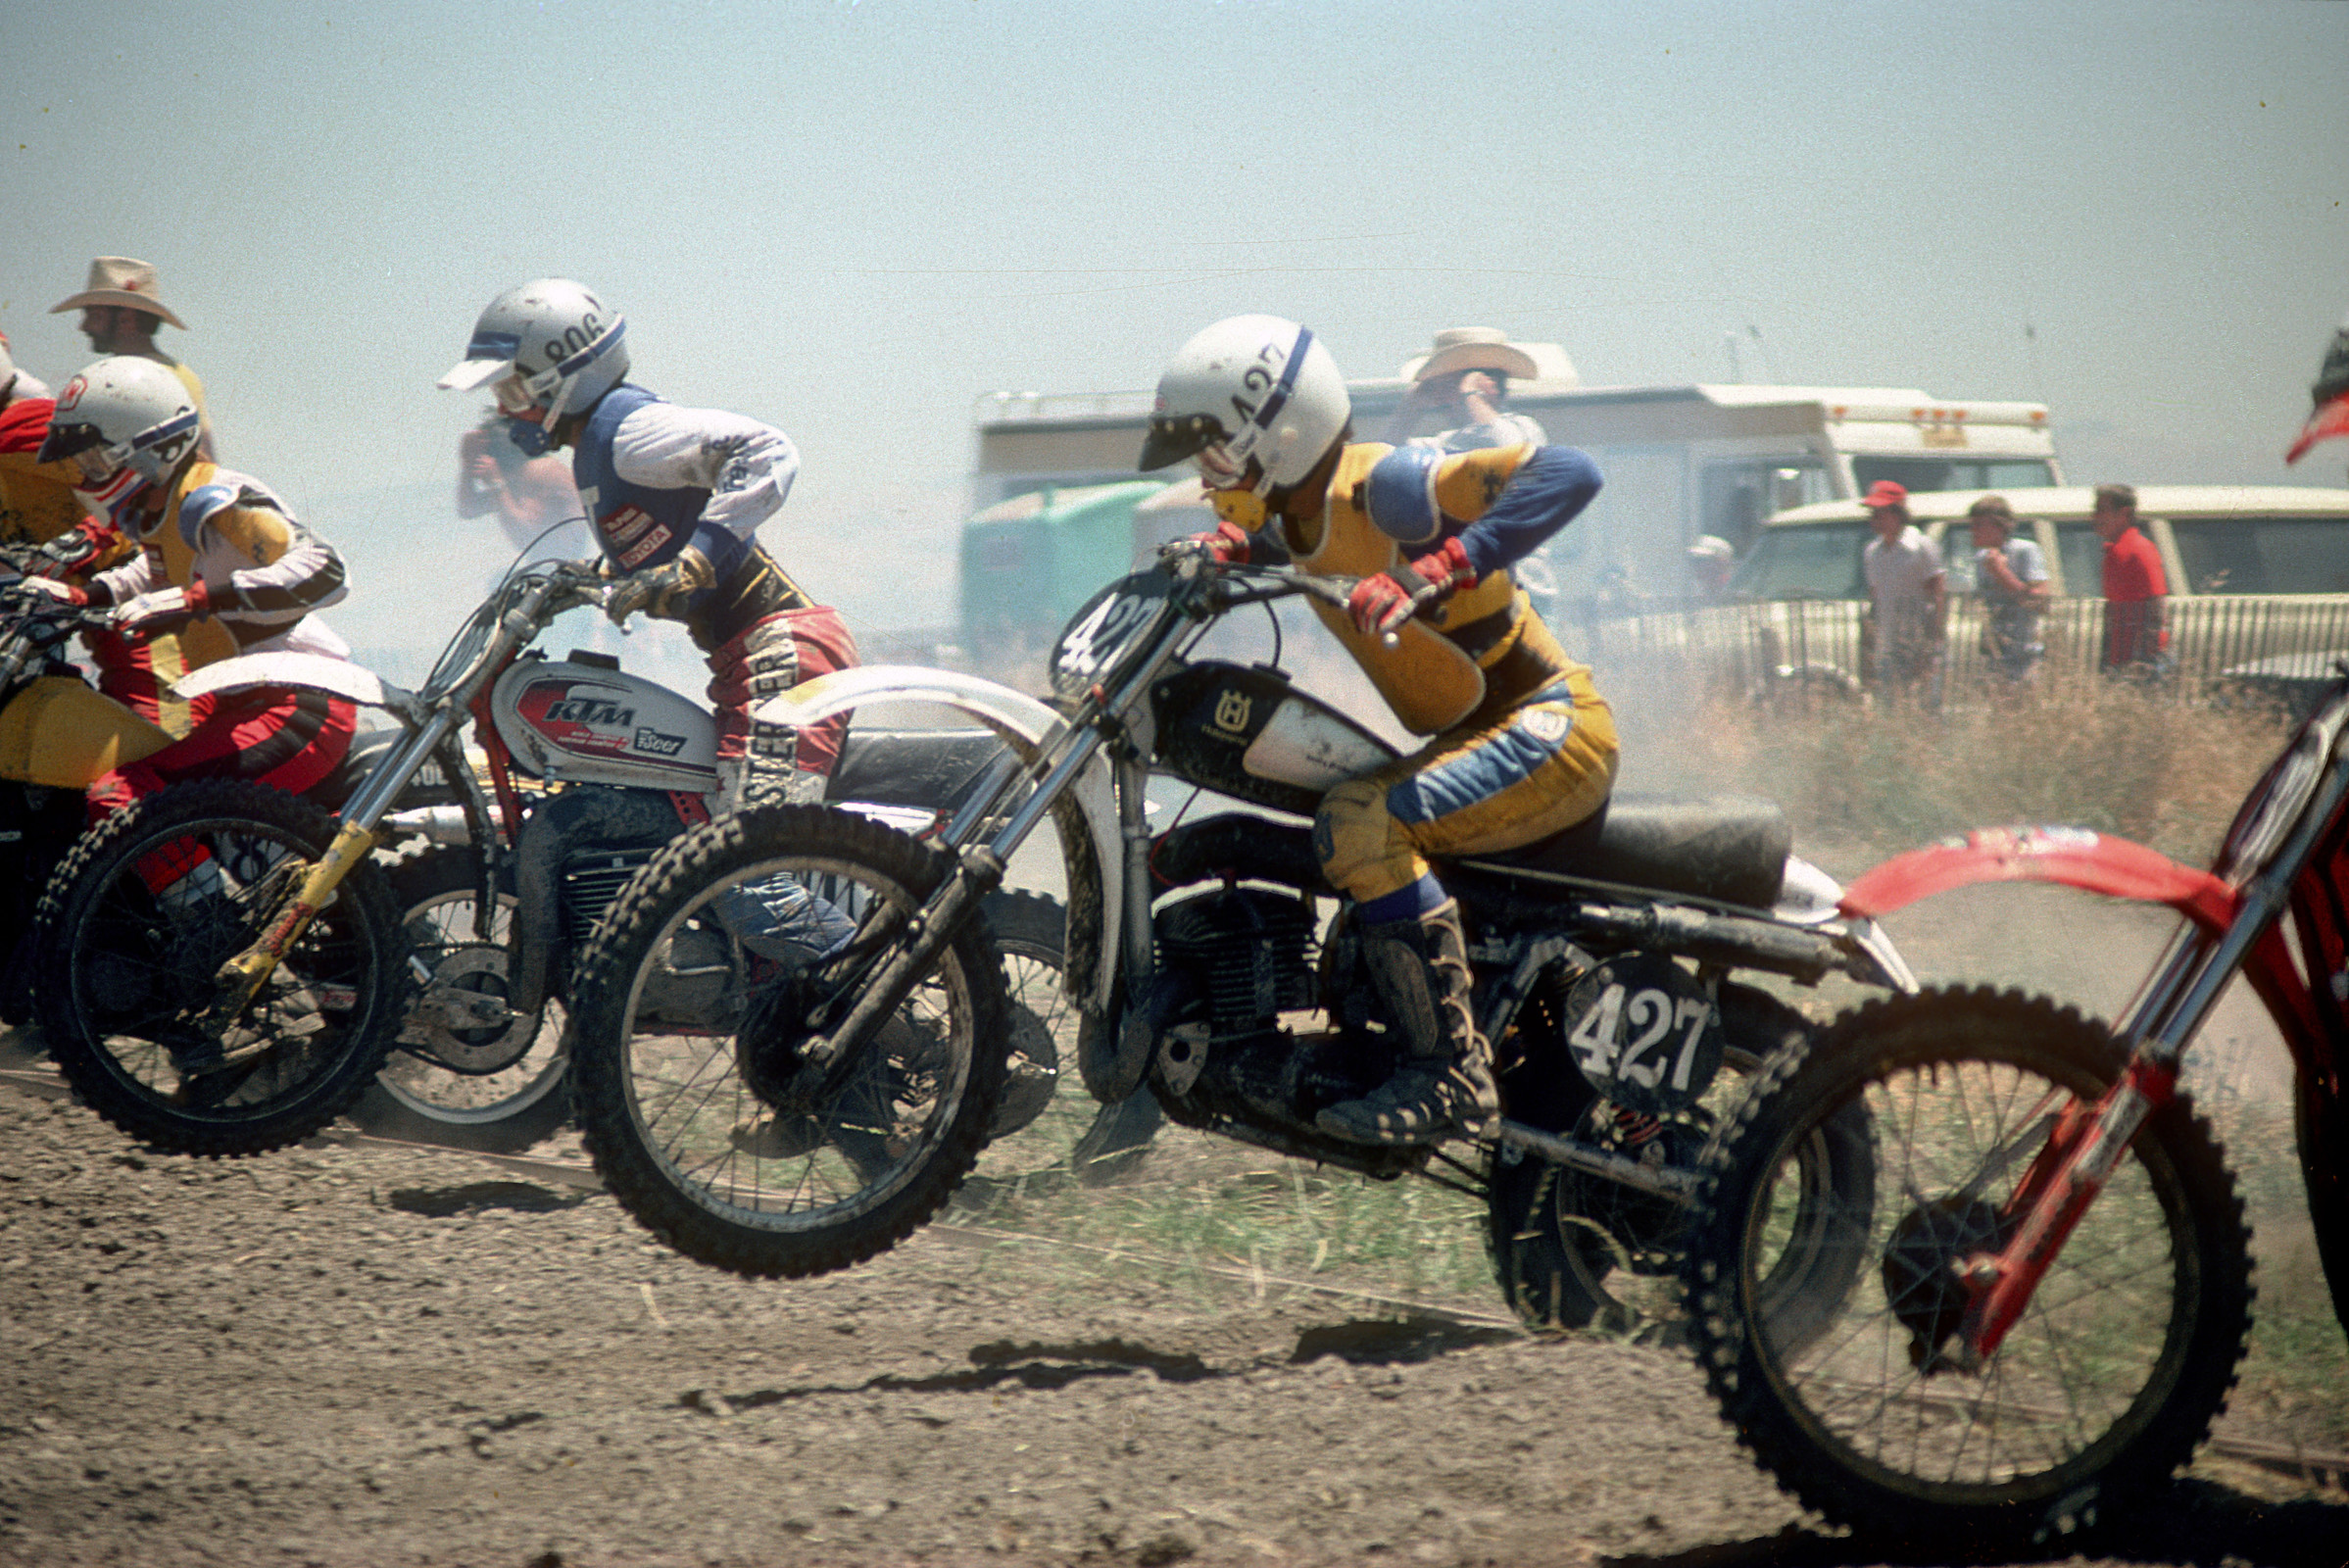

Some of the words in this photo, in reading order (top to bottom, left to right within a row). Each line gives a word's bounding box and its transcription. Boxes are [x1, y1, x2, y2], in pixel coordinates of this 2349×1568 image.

[619, 530, 665, 563] TOYOTA
[1058, 591, 1170, 675] 427
[542, 697, 636, 727] KTM
[1570, 983, 1711, 1091] 427
